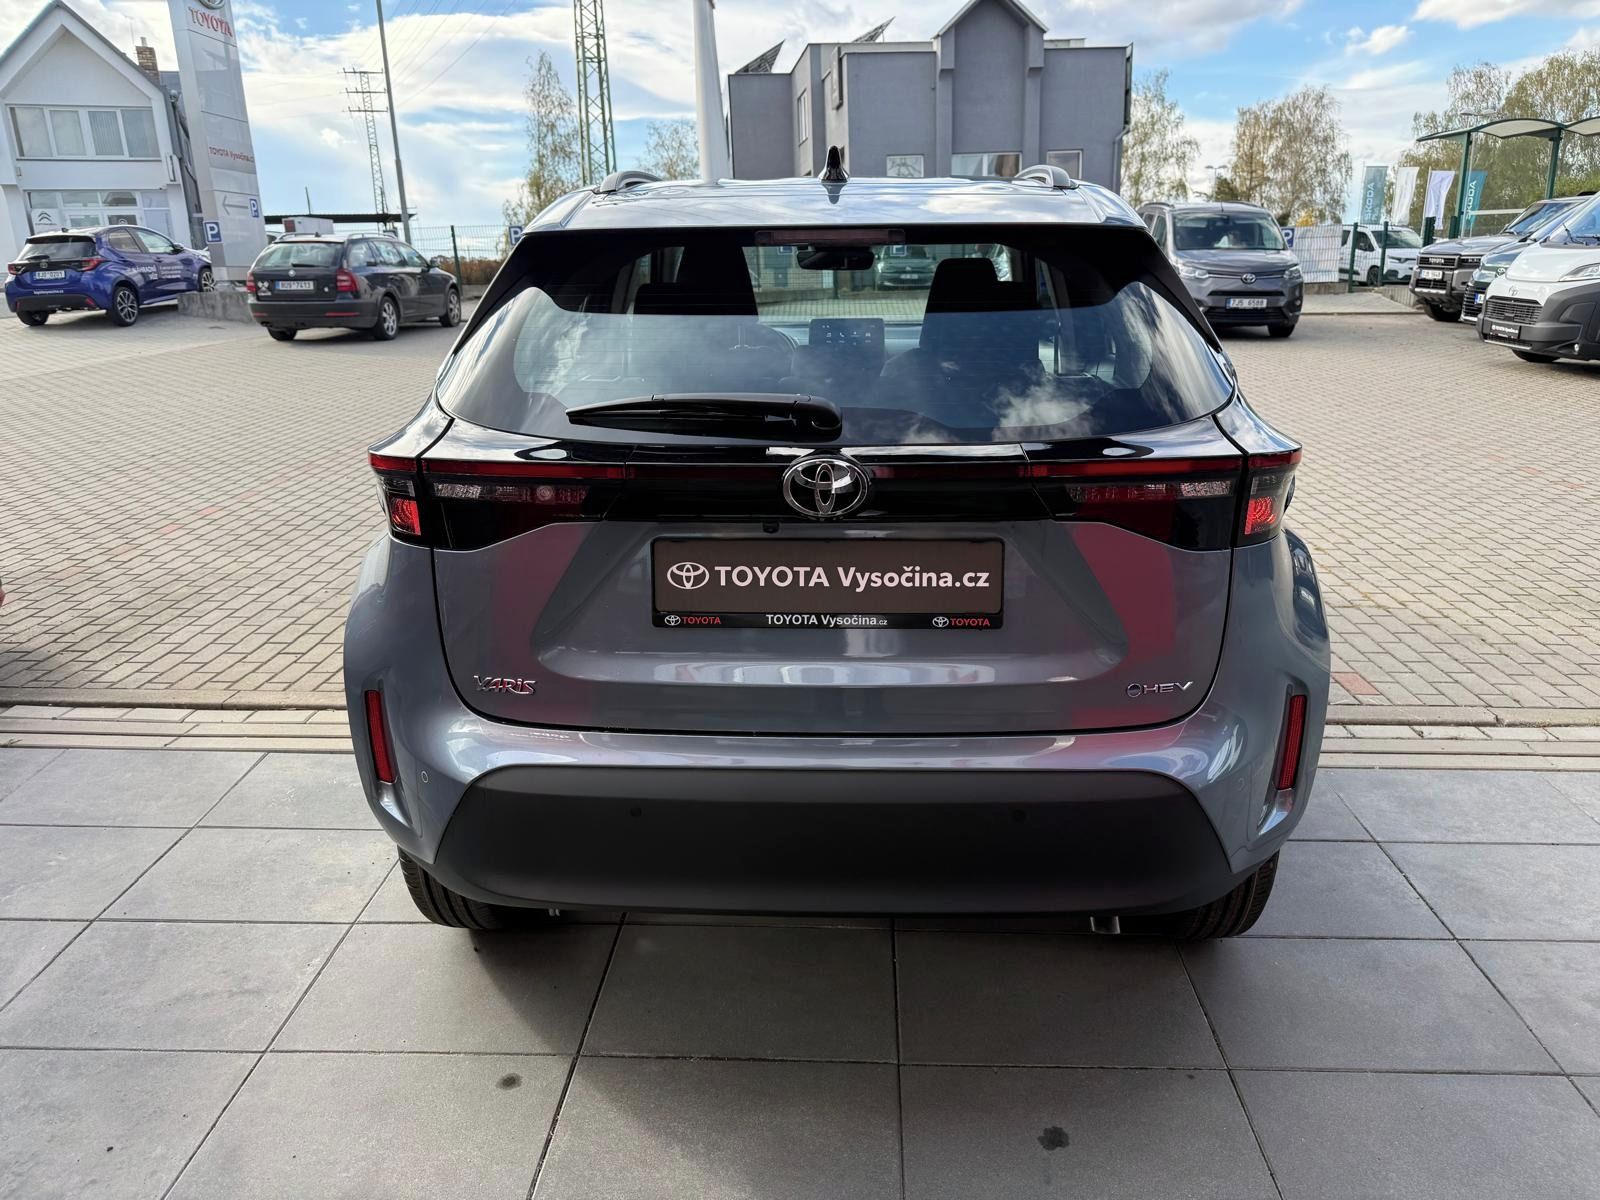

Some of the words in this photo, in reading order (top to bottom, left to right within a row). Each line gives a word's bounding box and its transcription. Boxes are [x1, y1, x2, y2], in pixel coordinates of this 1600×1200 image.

[188, 7, 232, 37] TOYOTA
[208, 146, 229, 157] TOYOTA
[206, 223, 218, 241] P
[510, 227, 521, 245] P
[714, 565, 830, 588] TOYOTA
[837, 565, 990, 593] Vysočina.cz
[681, 616, 722, 625] TOYOTA
[766, 614, 818, 625] TOYOTA
[821, 614, 888, 628] Vysočina.cz
[950, 617, 991, 626] TOYOTA
[1143, 681, 1194, 695] HEV
